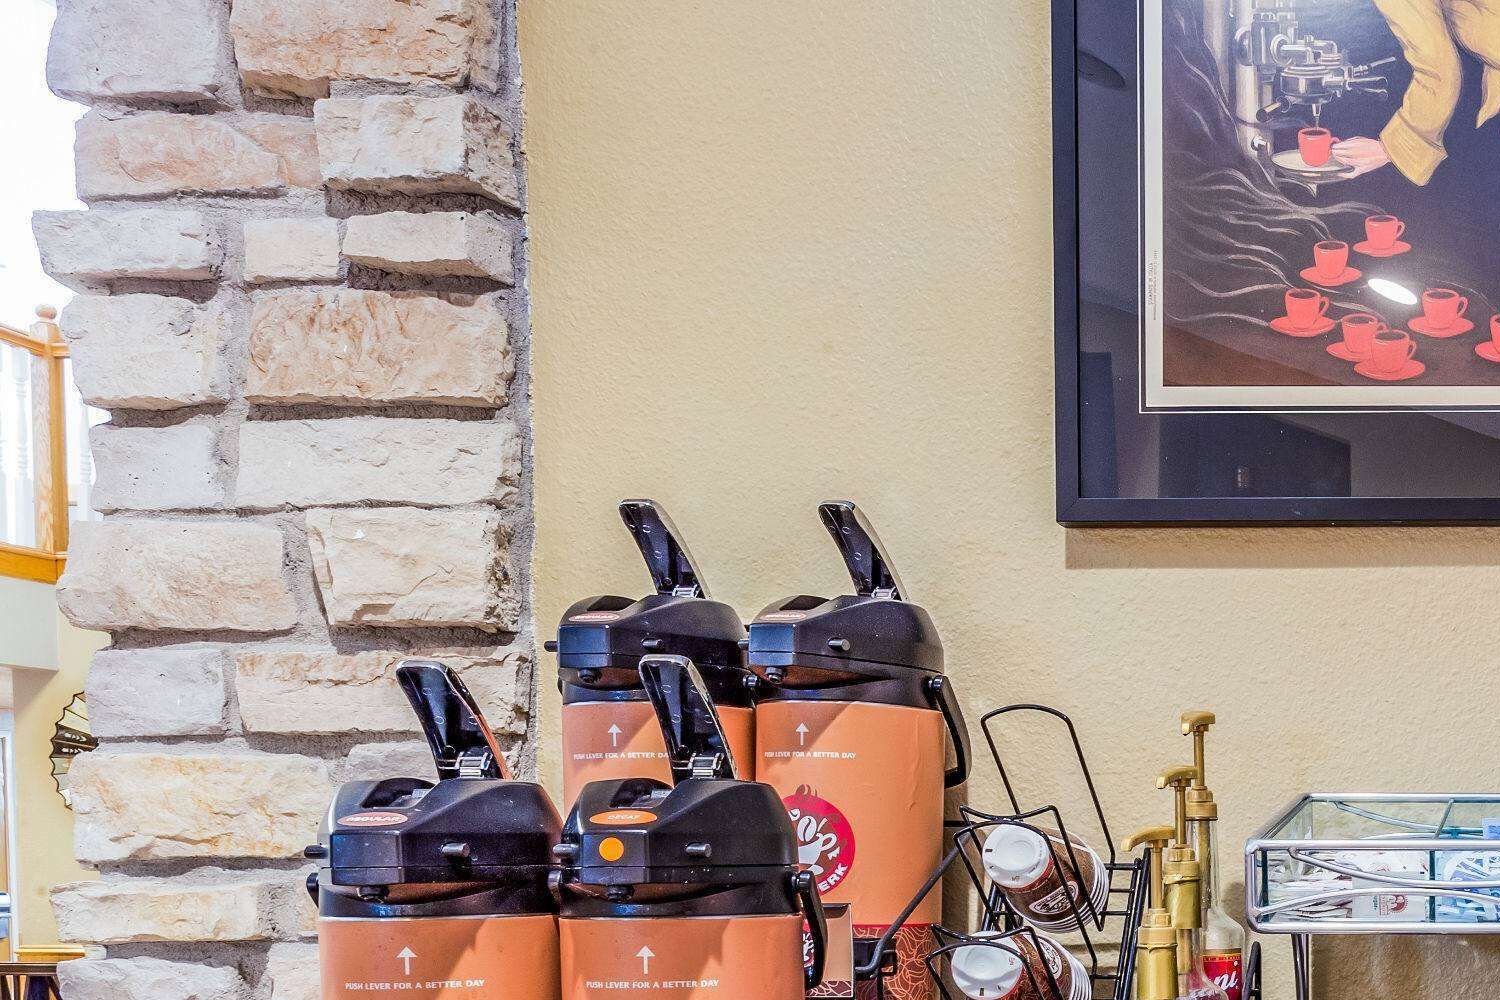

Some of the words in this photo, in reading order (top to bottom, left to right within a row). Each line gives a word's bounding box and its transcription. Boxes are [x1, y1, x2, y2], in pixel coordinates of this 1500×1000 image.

[813, 751, 840, 759] BETTER
[841, 751, 857, 759] DAY
[816, 862, 849, 893] ERK
[345, 982, 363, 990] PUSH
[365, 982, 391, 990] LEVER
[393, 982, 412, 990] FOR
[425, 980, 462, 989] BETTER
[465, 979, 486, 987] DAY
[605, 981, 630, 989] LEVER
[632, 980, 650, 989] FOR
[662, 980, 698, 988] BETTER
[700, 979, 720, 988] DAY
